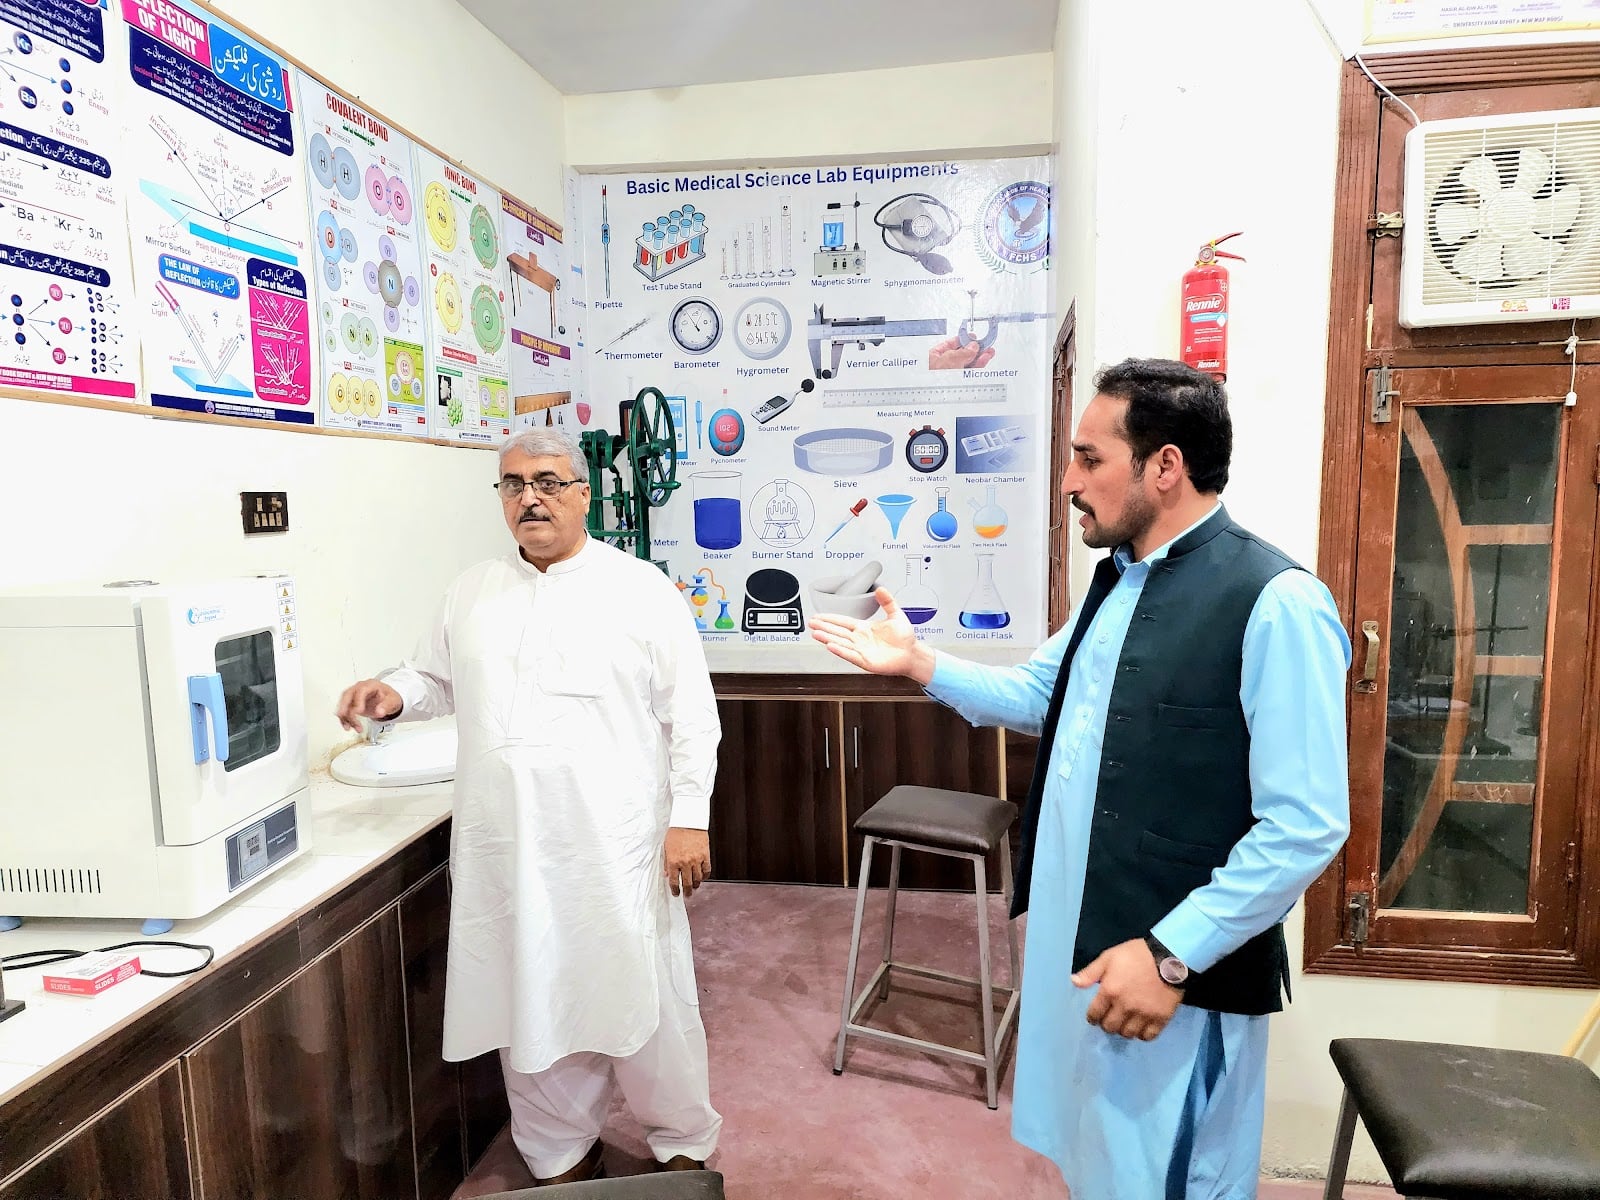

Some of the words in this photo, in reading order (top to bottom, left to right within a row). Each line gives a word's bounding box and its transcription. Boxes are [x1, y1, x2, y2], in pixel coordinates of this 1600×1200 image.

[1453, 20, 1484, 28] UNIVERSITY
[138, 7, 157, 32] OF
[160, 20, 197, 57] LIGHT
[16, 36, 29, 51] Kr
[259, 66, 282, 100] روشنی
[21, 90, 35, 105] Ba
[88, 98, 109, 115] Energy
[326, 92, 367, 129] COVALENT
[367, 117, 389, 142] BOND
[55, 127, 89, 146] Neutrons
[150, 115, 177, 146] Incident
[177, 145, 188, 161] Ray
[167, 153, 173, 163] A
[320, 155, 326, 168] H
[343, 168, 350, 181] H
[627, 178, 670, 195] Basic
[675, 174, 741, 192] Medical
[745, 172, 811, 188] Science
[817, 167, 847, 183] Lab
[853, 162, 959, 185] Equipments
[444, 165, 461, 186] IONIC
[461, 176, 477, 195] BOND
[260, 180, 283, 195] Reflected
[267, 202, 273, 210] B
[17, 207, 34, 221] Ba
[58, 218, 71, 231] Kr
[145, 235, 168, 249] Mirror
[168, 242, 192, 256] Surface
[195, 240, 210, 251] Point
[217, 247, 247, 263] Incidence
[1009, 253, 1037, 262] FCHS
[164, 257, 177, 269] THE
[178, 261, 191, 273] LAW
[192, 265, 200, 275] OF
[164, 269, 200, 287] REFLECTION
[811, 278, 846, 287] Magnetic
[847, 277, 872, 285] Stirrer
[884, 276, 965, 288] Sphygmomanometer
[252, 276, 269, 288] Types
[277, 282, 304, 296] Reflection
[388, 278, 394, 290] N
[642, 283, 658, 291] Test
[659, 283, 679, 291] Tube
[680, 281, 702, 290] Stand
[728, 280, 760, 289] Graduated
[595, 301, 623, 310] Pipette
[1186, 297, 1221, 313] Rennie
[151, 309, 168, 318] Light
[604, 351, 664, 361] Thermometer
[674, 360, 721, 369] Barometer
[846, 358, 880, 369] Vernier
[882, 357, 919, 369] Calliper
[1197, 361, 1220, 369] Rennie
[736, 366, 790, 377] Hygrometer
[963, 369, 1019, 378] Micrometer
[877, 410, 913, 418] Measuring
[914, 409, 935, 417] Meter
[758, 425, 779, 433] Sound
[780, 424, 801, 432] Meter
[914, 444, 940, 455] 60:00
[711, 457, 747, 465] Pycnometer
[833, 480, 858, 488] Sieve
[926, 475, 947, 483] Watch
[965, 476, 991, 484] Neobar
[993, 476, 1025, 484] Chamber
[653, 538, 679, 546] Meter
[882, 542, 909, 550] Funnel
[703, 551, 733, 560] Beaker
[752, 551, 783, 559] Burner
[786, 550, 814, 559] Stand
[825, 551, 865, 561] Dropper
[914, 626, 944, 634] Bottom
[744, 634, 768, 644] Digital
[770, 634, 800, 642] Balance
[956, 631, 989, 640] Conical
[991, 631, 1014, 640] Flask
[50, 982, 72, 991] SLIDES
[95, 976, 115, 991] SLIDES
